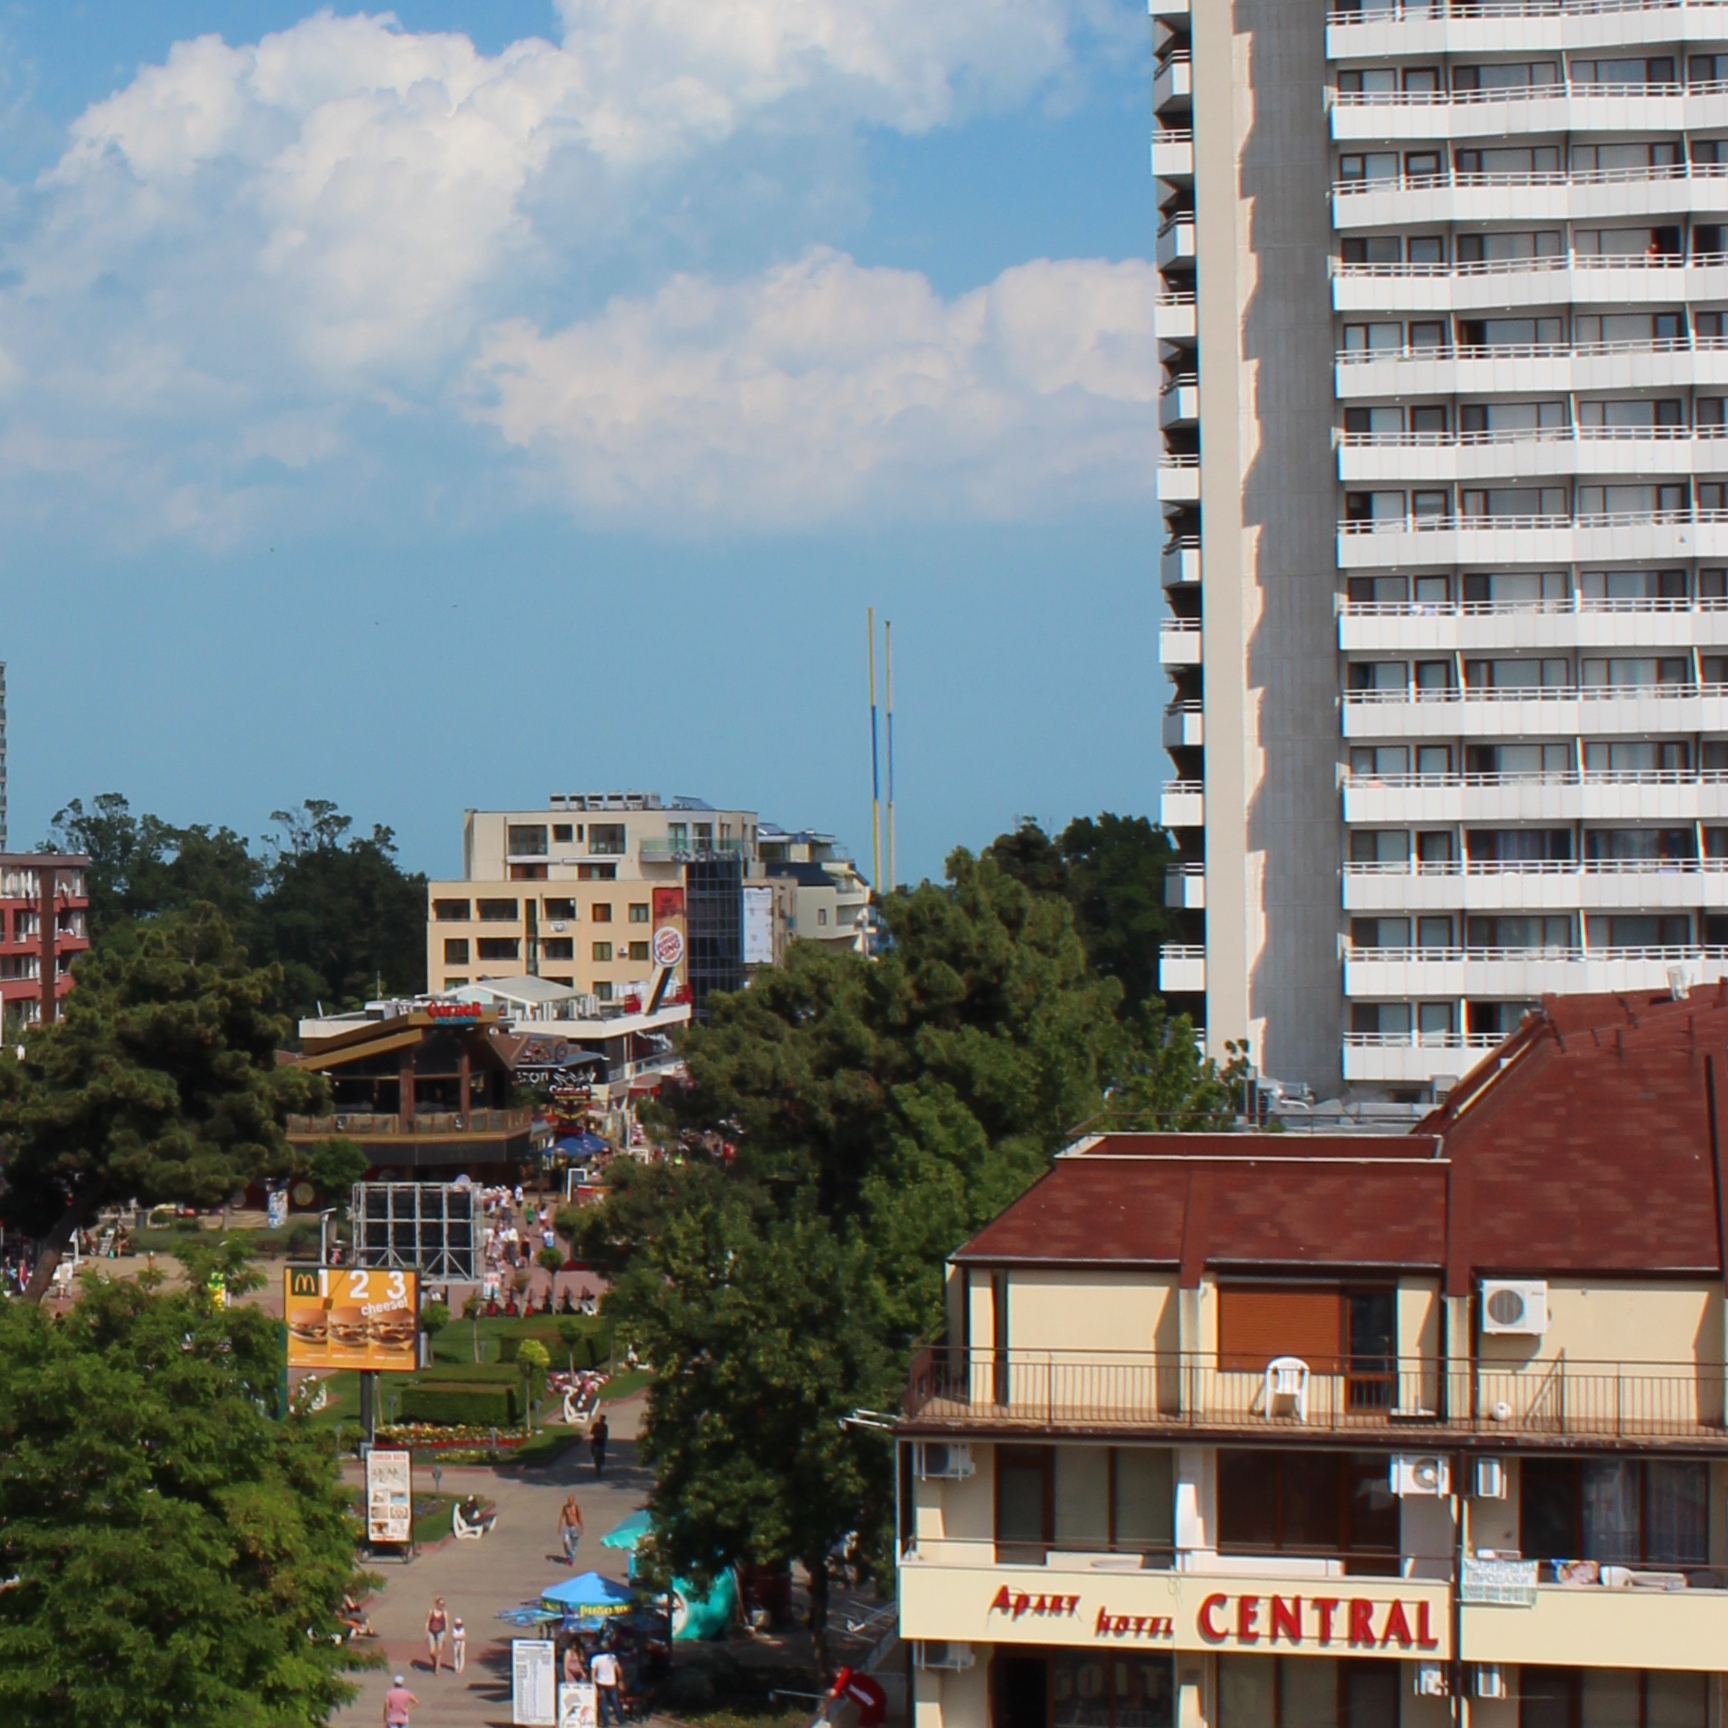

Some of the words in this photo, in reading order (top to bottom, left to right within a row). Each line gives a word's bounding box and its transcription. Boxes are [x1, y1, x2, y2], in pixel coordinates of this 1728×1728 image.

[318, 1269, 328, 1298] 1
[349, 1270, 369, 1299] 2
[386, 1271, 406, 1300] 3
[360, 1296, 408, 1316] cheese!
[1197, 1592, 1439, 1649] CENTRAL
